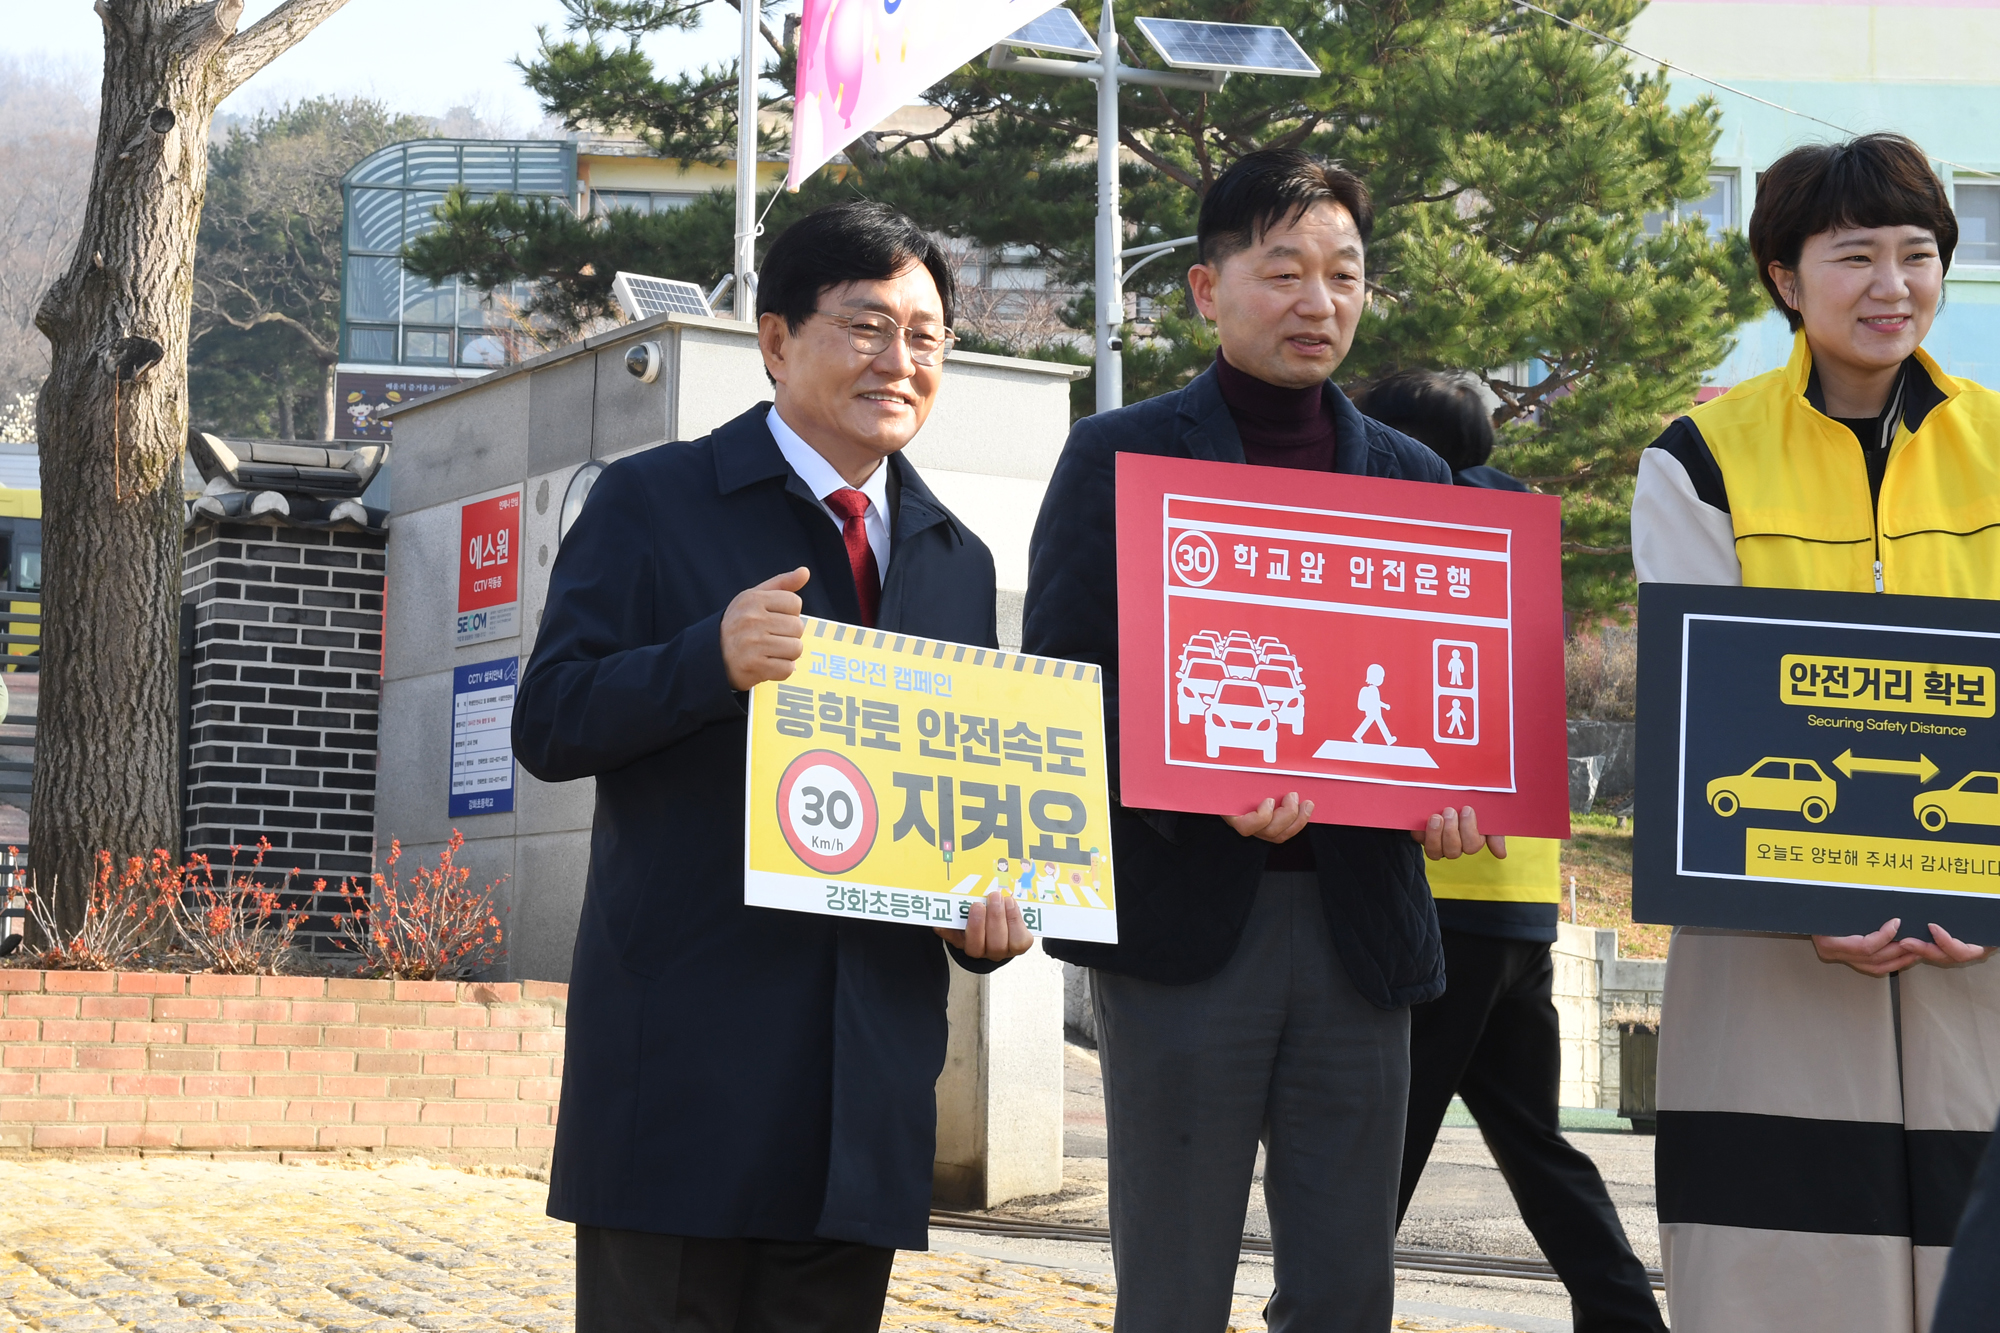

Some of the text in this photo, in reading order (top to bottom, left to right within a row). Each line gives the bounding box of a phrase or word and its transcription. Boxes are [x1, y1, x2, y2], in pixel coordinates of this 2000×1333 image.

[469, 528, 509, 570] 에스원
[473, 575, 502, 593] CCTV 작동중
[1178, 543, 1472, 599] 30 학교앞 안전운행
[457, 612, 487, 634] SECOM
[468, 667, 503, 685] CCTV 설치안내
[808, 651, 953, 698] 교통안전 캠페인
[1789, 662, 1987, 708] 안전거리 확보
[775, 683, 1087, 778] 통학로 안전속도
[1807, 714, 1967, 737] Securing Safety Distance
[801, 785, 854, 831] 30
[892, 771, 1091, 867] 지켜요
[811, 835, 844, 852] Km/h
[1756, 843, 2000, 877] 오늘도 양보해 주셔서 감사합니다
[825, 884, 953, 923] 강화초등학교
